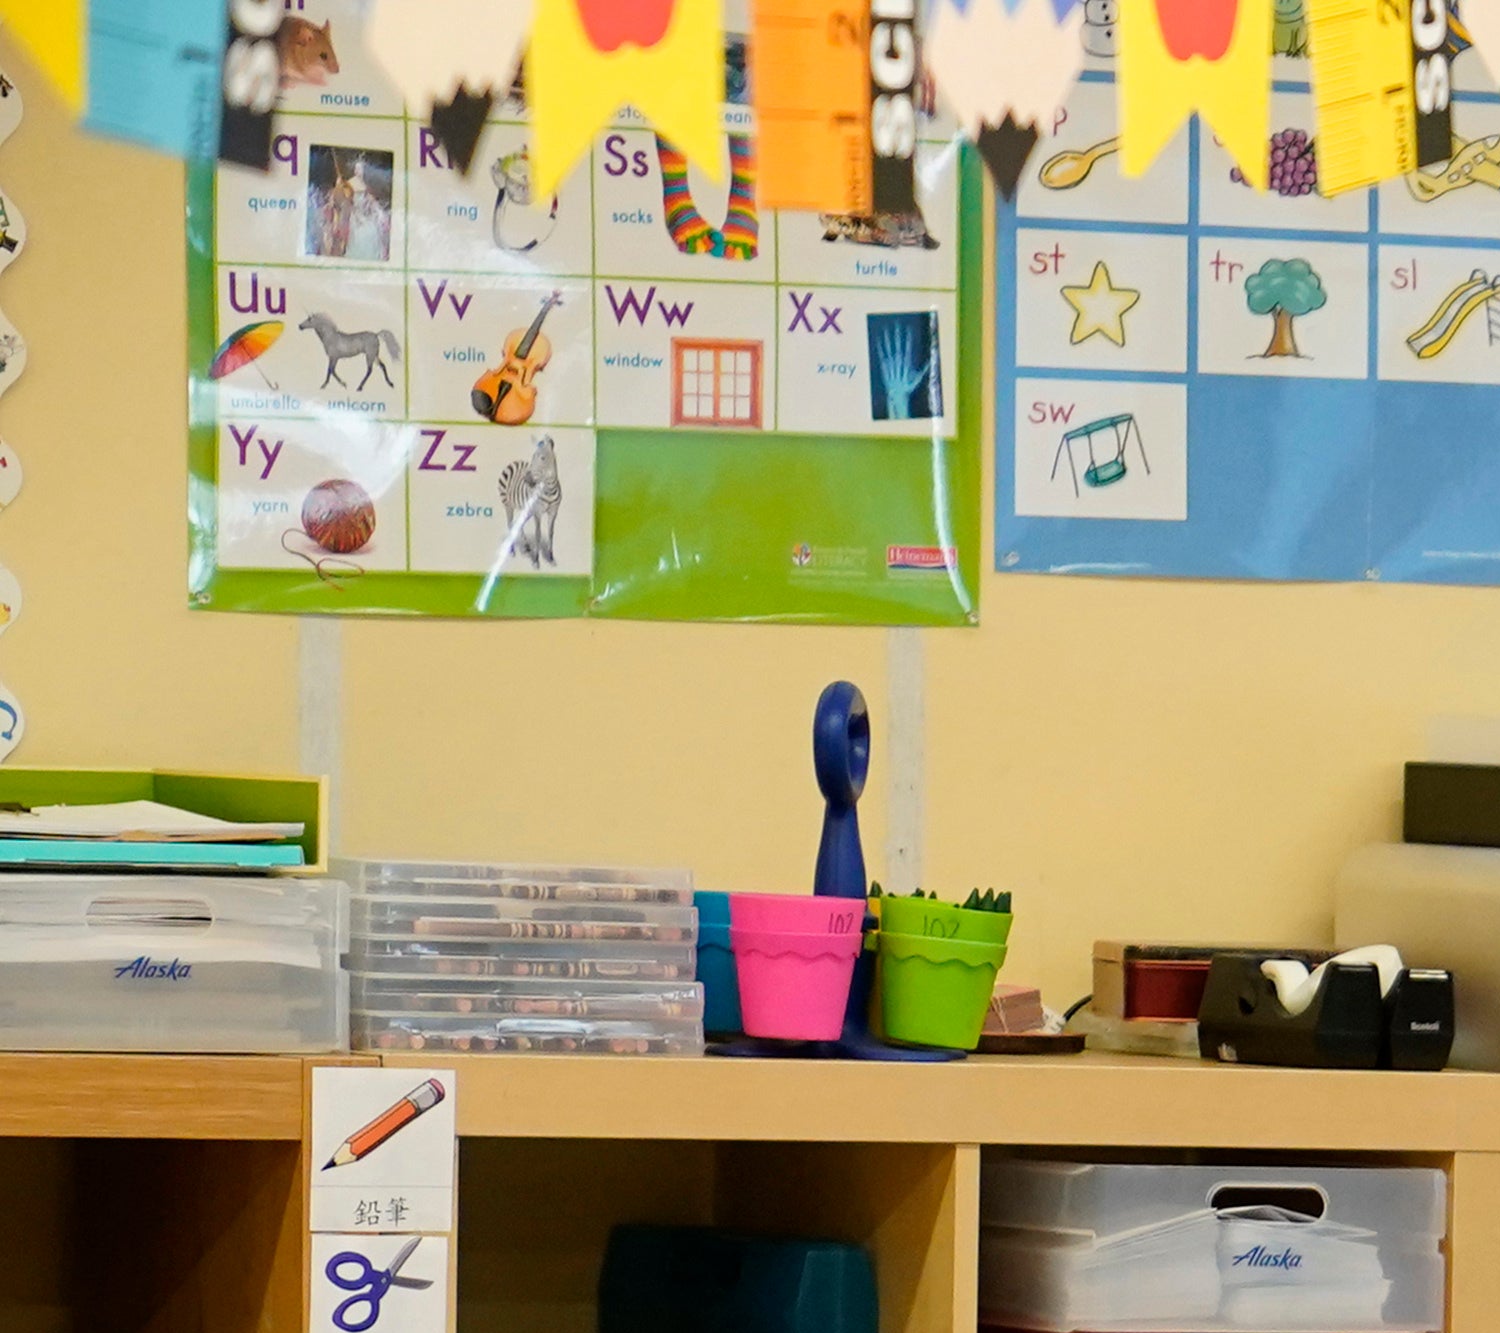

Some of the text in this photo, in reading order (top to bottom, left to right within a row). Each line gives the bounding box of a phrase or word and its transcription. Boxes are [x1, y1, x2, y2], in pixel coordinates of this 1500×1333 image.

[321, 94, 369, 106] mouse
[604, 135, 648, 177] Ss
[248, 198, 296, 212] queen
[447, 206, 477, 221] ring
[613, 209, 653, 224] socks
[856, 260, 897, 276] turtle
[1030, 243, 1065, 274] st
[1210, 250, 1243, 283] tr
[1391, 259, 1416, 290] sl
[229, 272, 286, 314] Uu
[419, 280, 472, 320] Vv
[605, 285, 693, 327] Ww
[788, 292, 842, 333] Xx
[443, 347, 485, 362] violin
[604, 353, 663, 367] window
[818, 364, 856, 379] x-ray
[324, 397, 386, 416] unicorn
[1028, 402, 1075, 424] sw
[229, 425, 283, 479] Yy
[418, 430, 476, 471] Zz
[253, 502, 288, 515] yarn
[447, 502, 493, 517] zebra
[112, 953, 194, 981] Alaska
[355, 1197, 409, 1226] 鉛筆
[1233, 1246, 1302, 1270] Alaska
